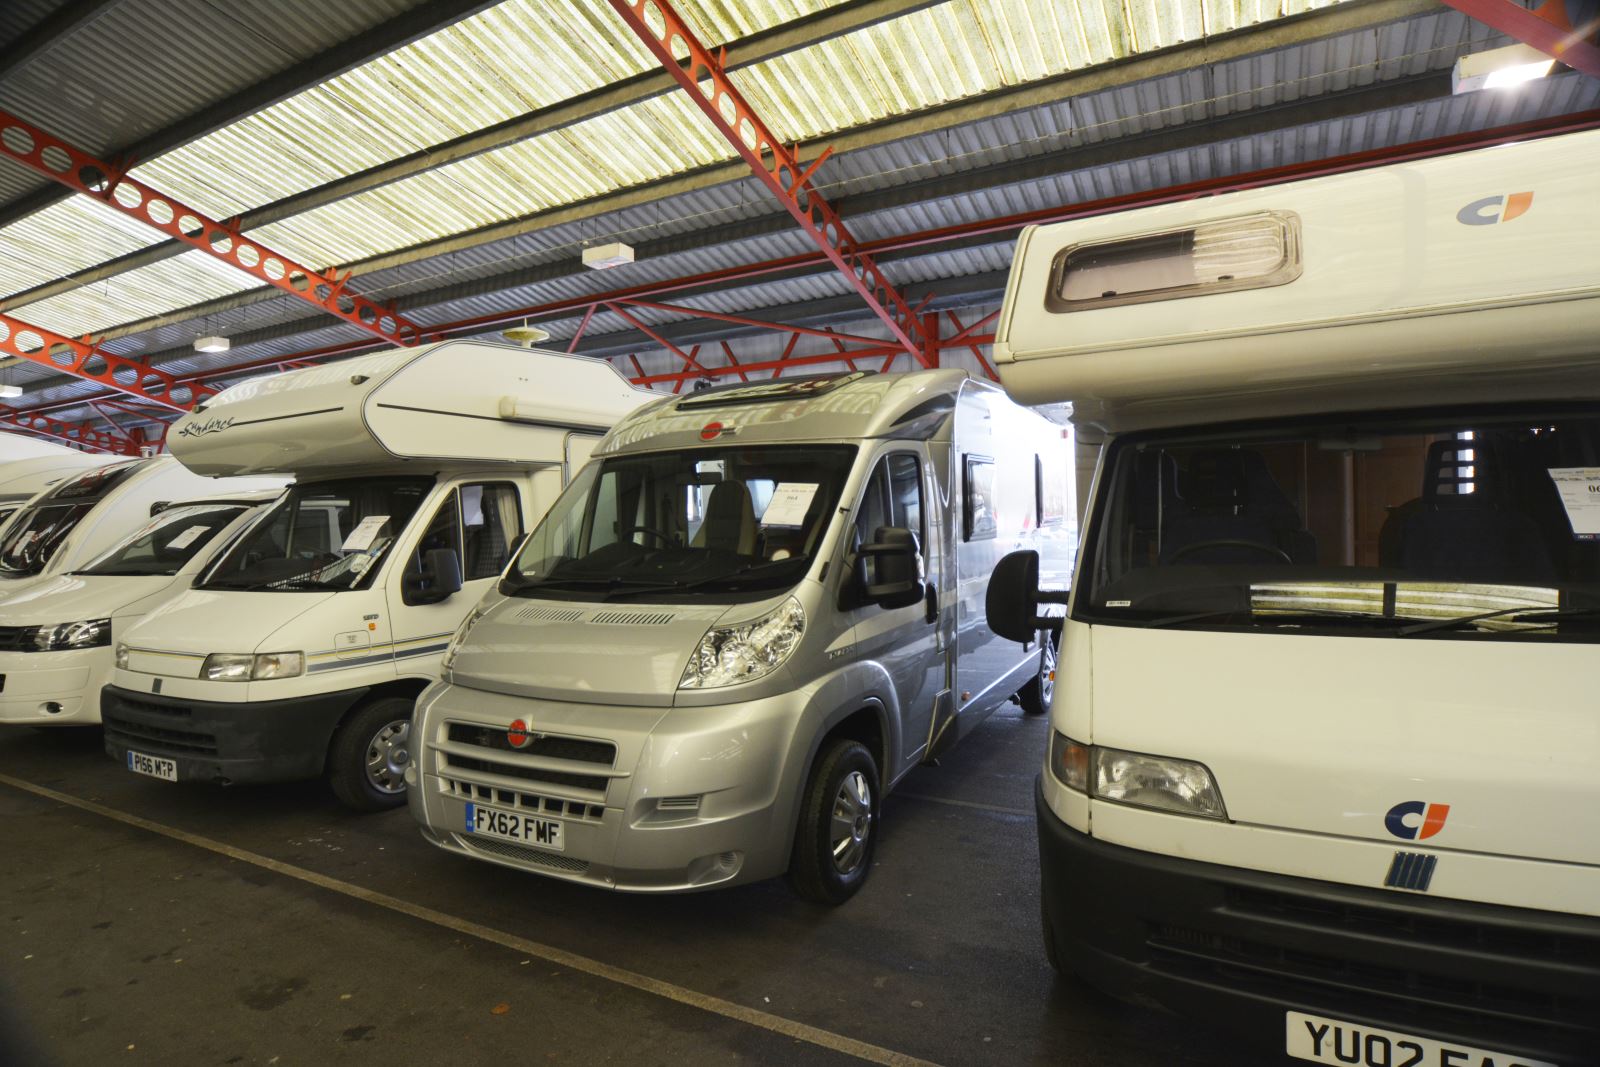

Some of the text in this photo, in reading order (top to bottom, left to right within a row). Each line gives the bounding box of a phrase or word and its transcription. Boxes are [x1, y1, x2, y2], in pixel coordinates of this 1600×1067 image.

[134, 754, 173, 778] P156 MTP
[476, 807, 560, 844] FX62 FMF
[1304, 1020, 1424, 1067] YU02
